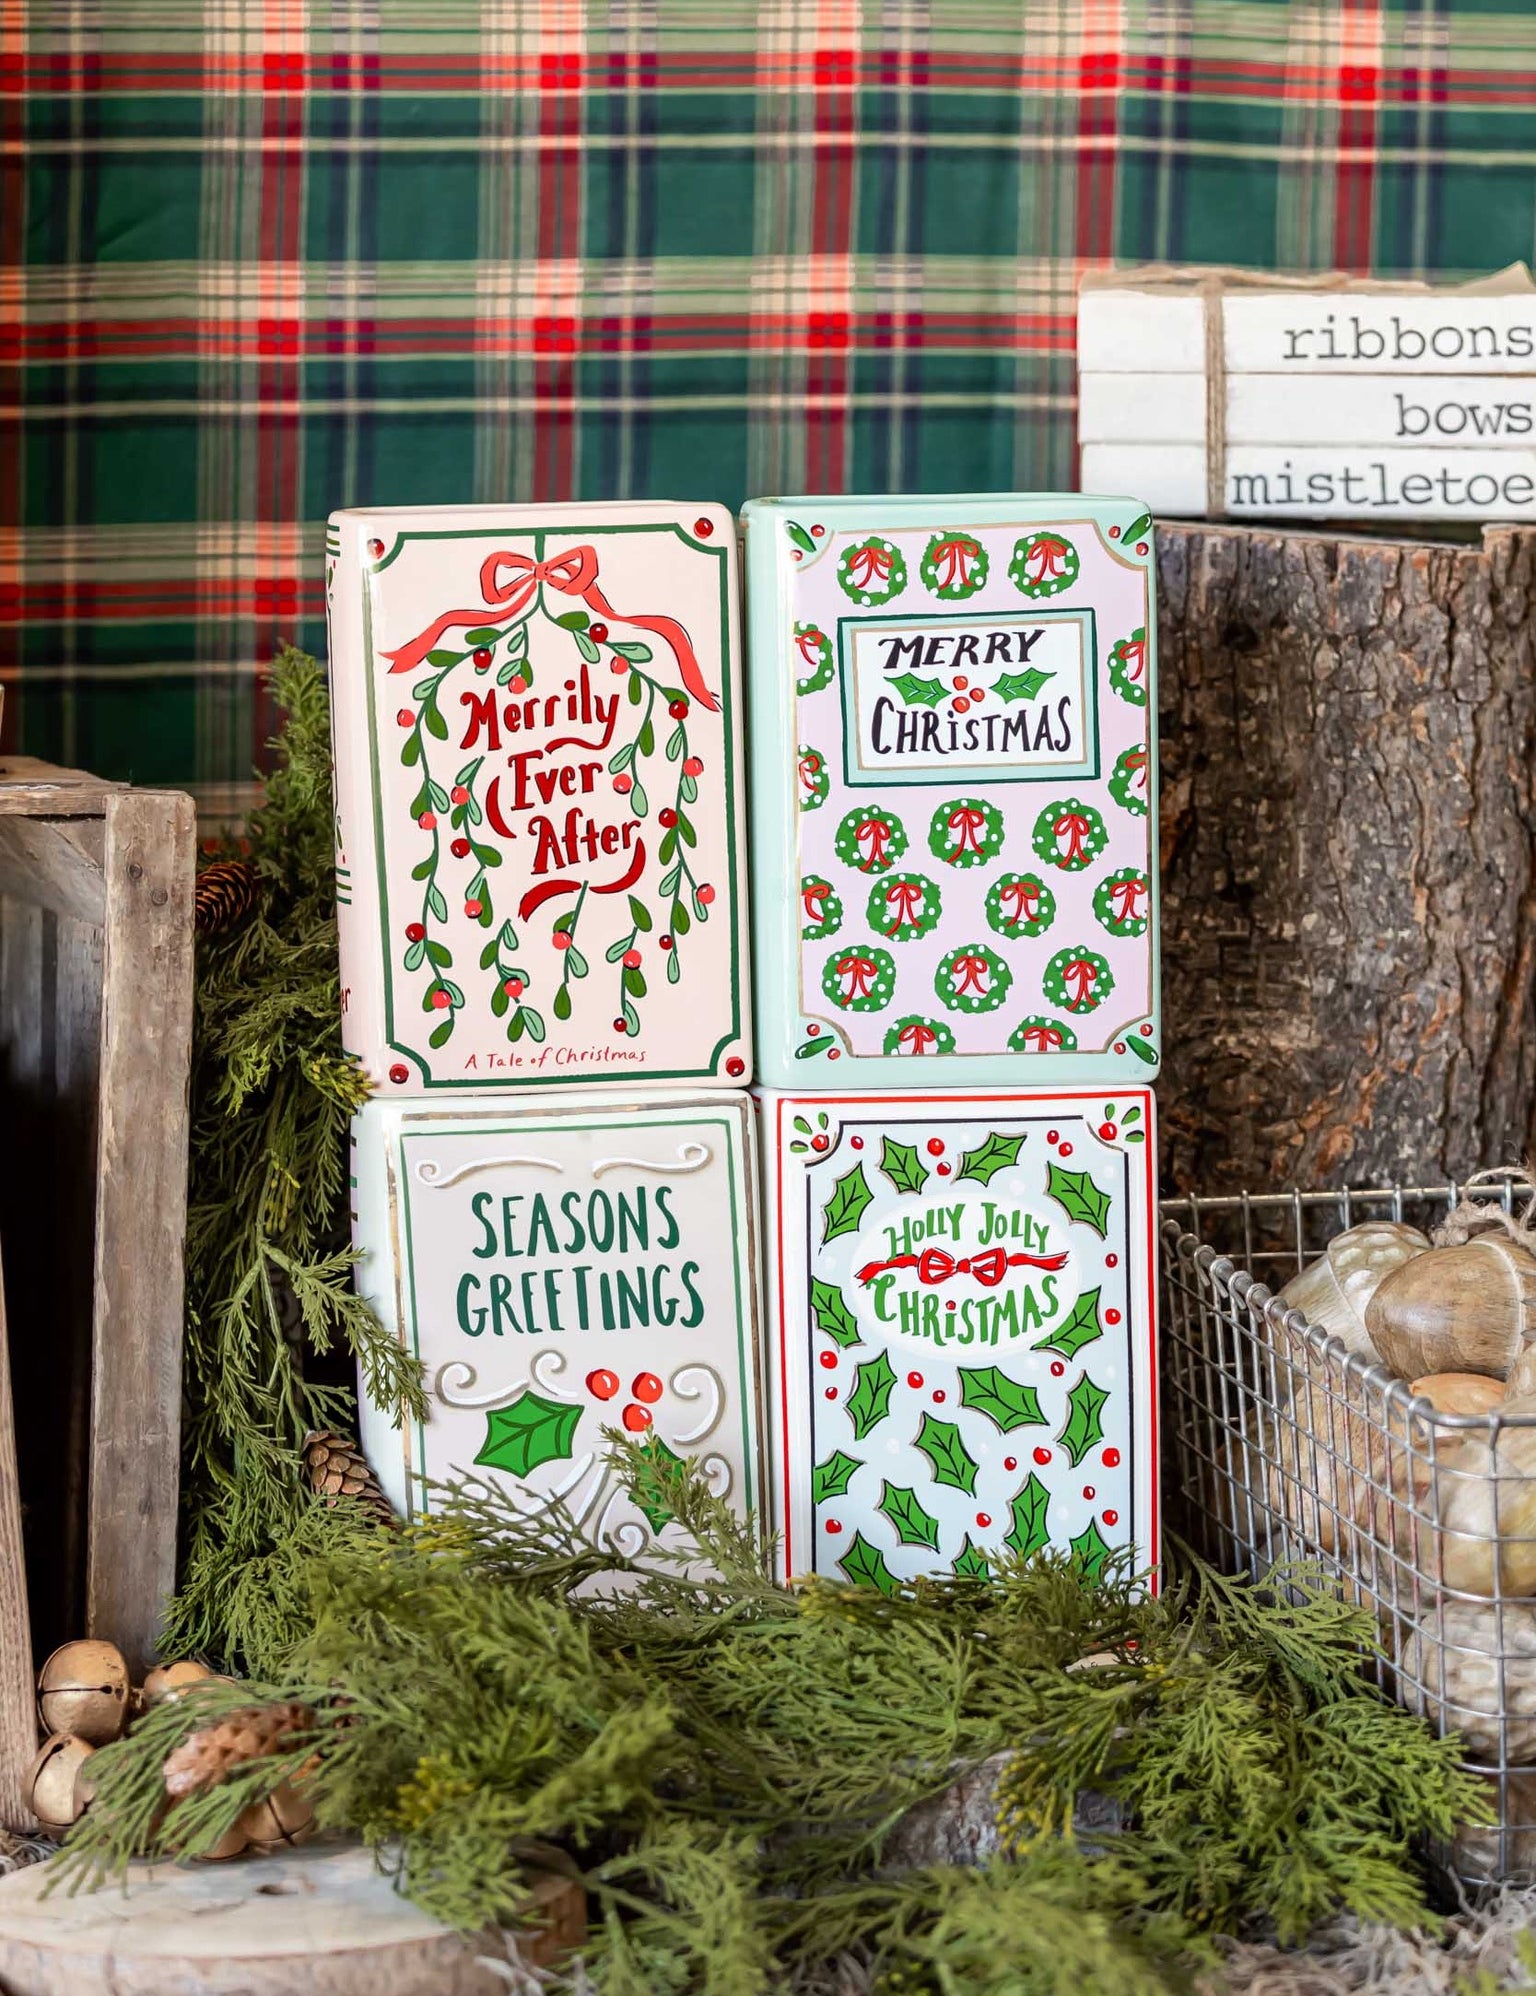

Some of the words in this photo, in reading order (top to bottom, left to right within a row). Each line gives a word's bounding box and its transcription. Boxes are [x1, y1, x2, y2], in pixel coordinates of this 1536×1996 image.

[1282, 315, 1535, 360] ribbons
[1394, 394, 1534, 436] bows
[1232, 462, 1536, 508] mistletoe
[878, 629, 1046, 669] MERRY
[460, 664, 620, 754] Merrily
[507, 750, 604, 811] Ever
[528, 807, 642, 875] After
[464, 1054, 478, 1069] A
[487, 1053, 523, 1069] Tale
[530, 1047, 553, 1068] of
[555, 1046, 647, 1065] Christmas
[472, 1186, 680, 1259] SEASONS
[882, 1203, 966, 1262] HOLLY
[978, 1202, 1050, 1254] JOLLY
[456, 1261, 705, 1337] GREETINGS
